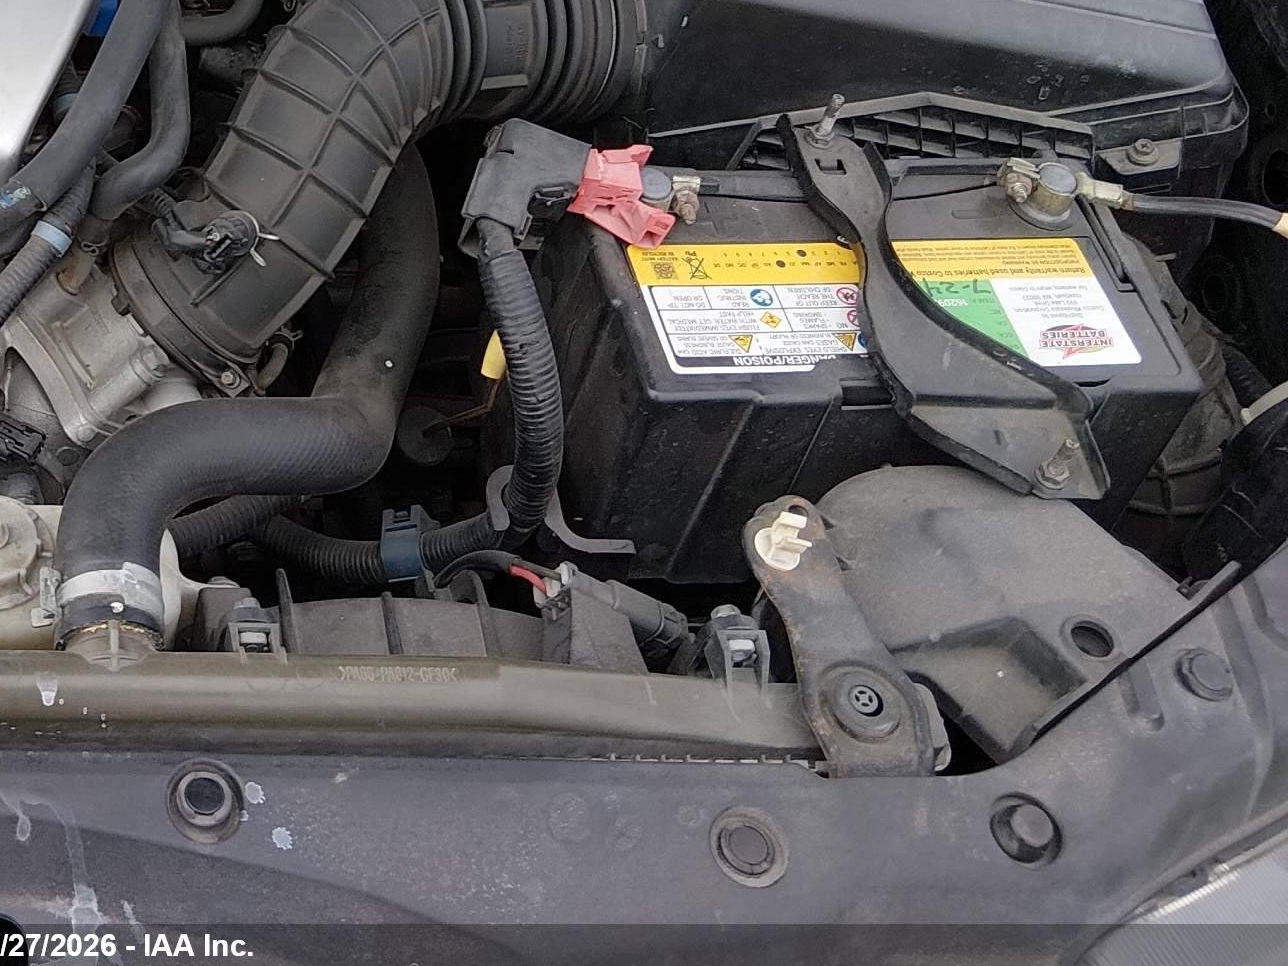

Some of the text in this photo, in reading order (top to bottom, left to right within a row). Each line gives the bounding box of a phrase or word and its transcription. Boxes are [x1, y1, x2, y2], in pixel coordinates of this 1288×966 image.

[954, 269, 989, 277] batteries
[991, 268, 1008, 276] used
[1010, 268, 1024, 276] and
[1025, 267, 1058, 275] warranty
[1041, 330, 1106, 340] BATTERIES
[1040, 339, 1113, 348] INTERSTATE
